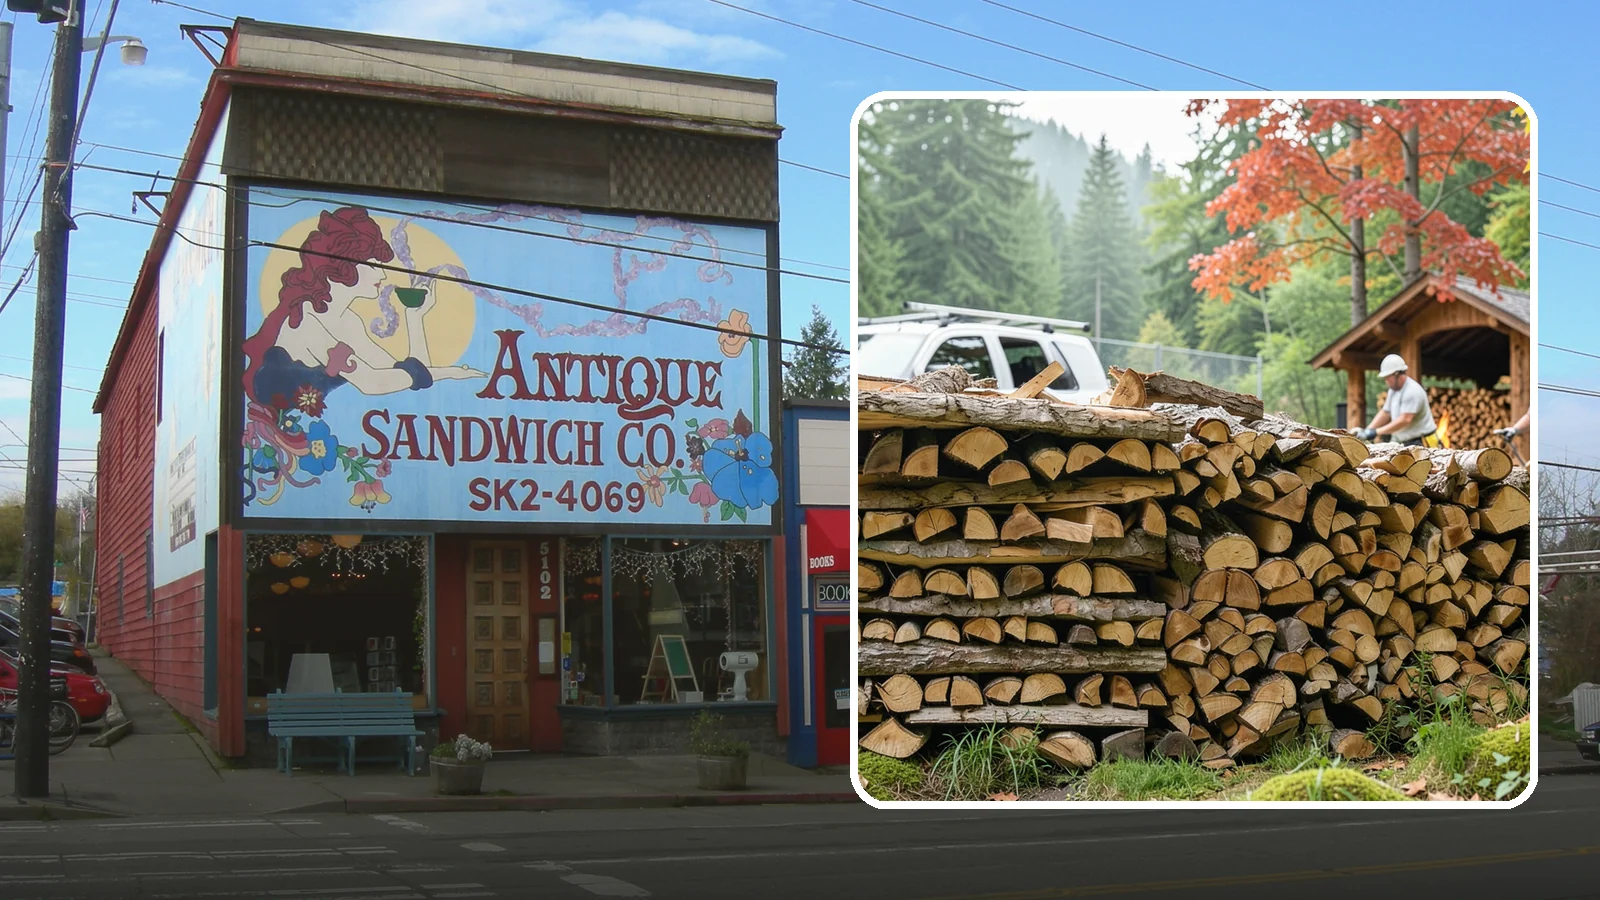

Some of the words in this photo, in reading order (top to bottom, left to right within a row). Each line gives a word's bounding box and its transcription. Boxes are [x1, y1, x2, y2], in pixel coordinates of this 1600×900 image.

[476, 329, 723, 420] ANTIQUE
[361, 409, 605, 467] SANDWICH
[617, 422, 685, 469] CO.
[468, 477, 645, 512] SK2-4069
[540, 541, 551, 600] 5102
[809, 555, 835, 569] BOOKS
